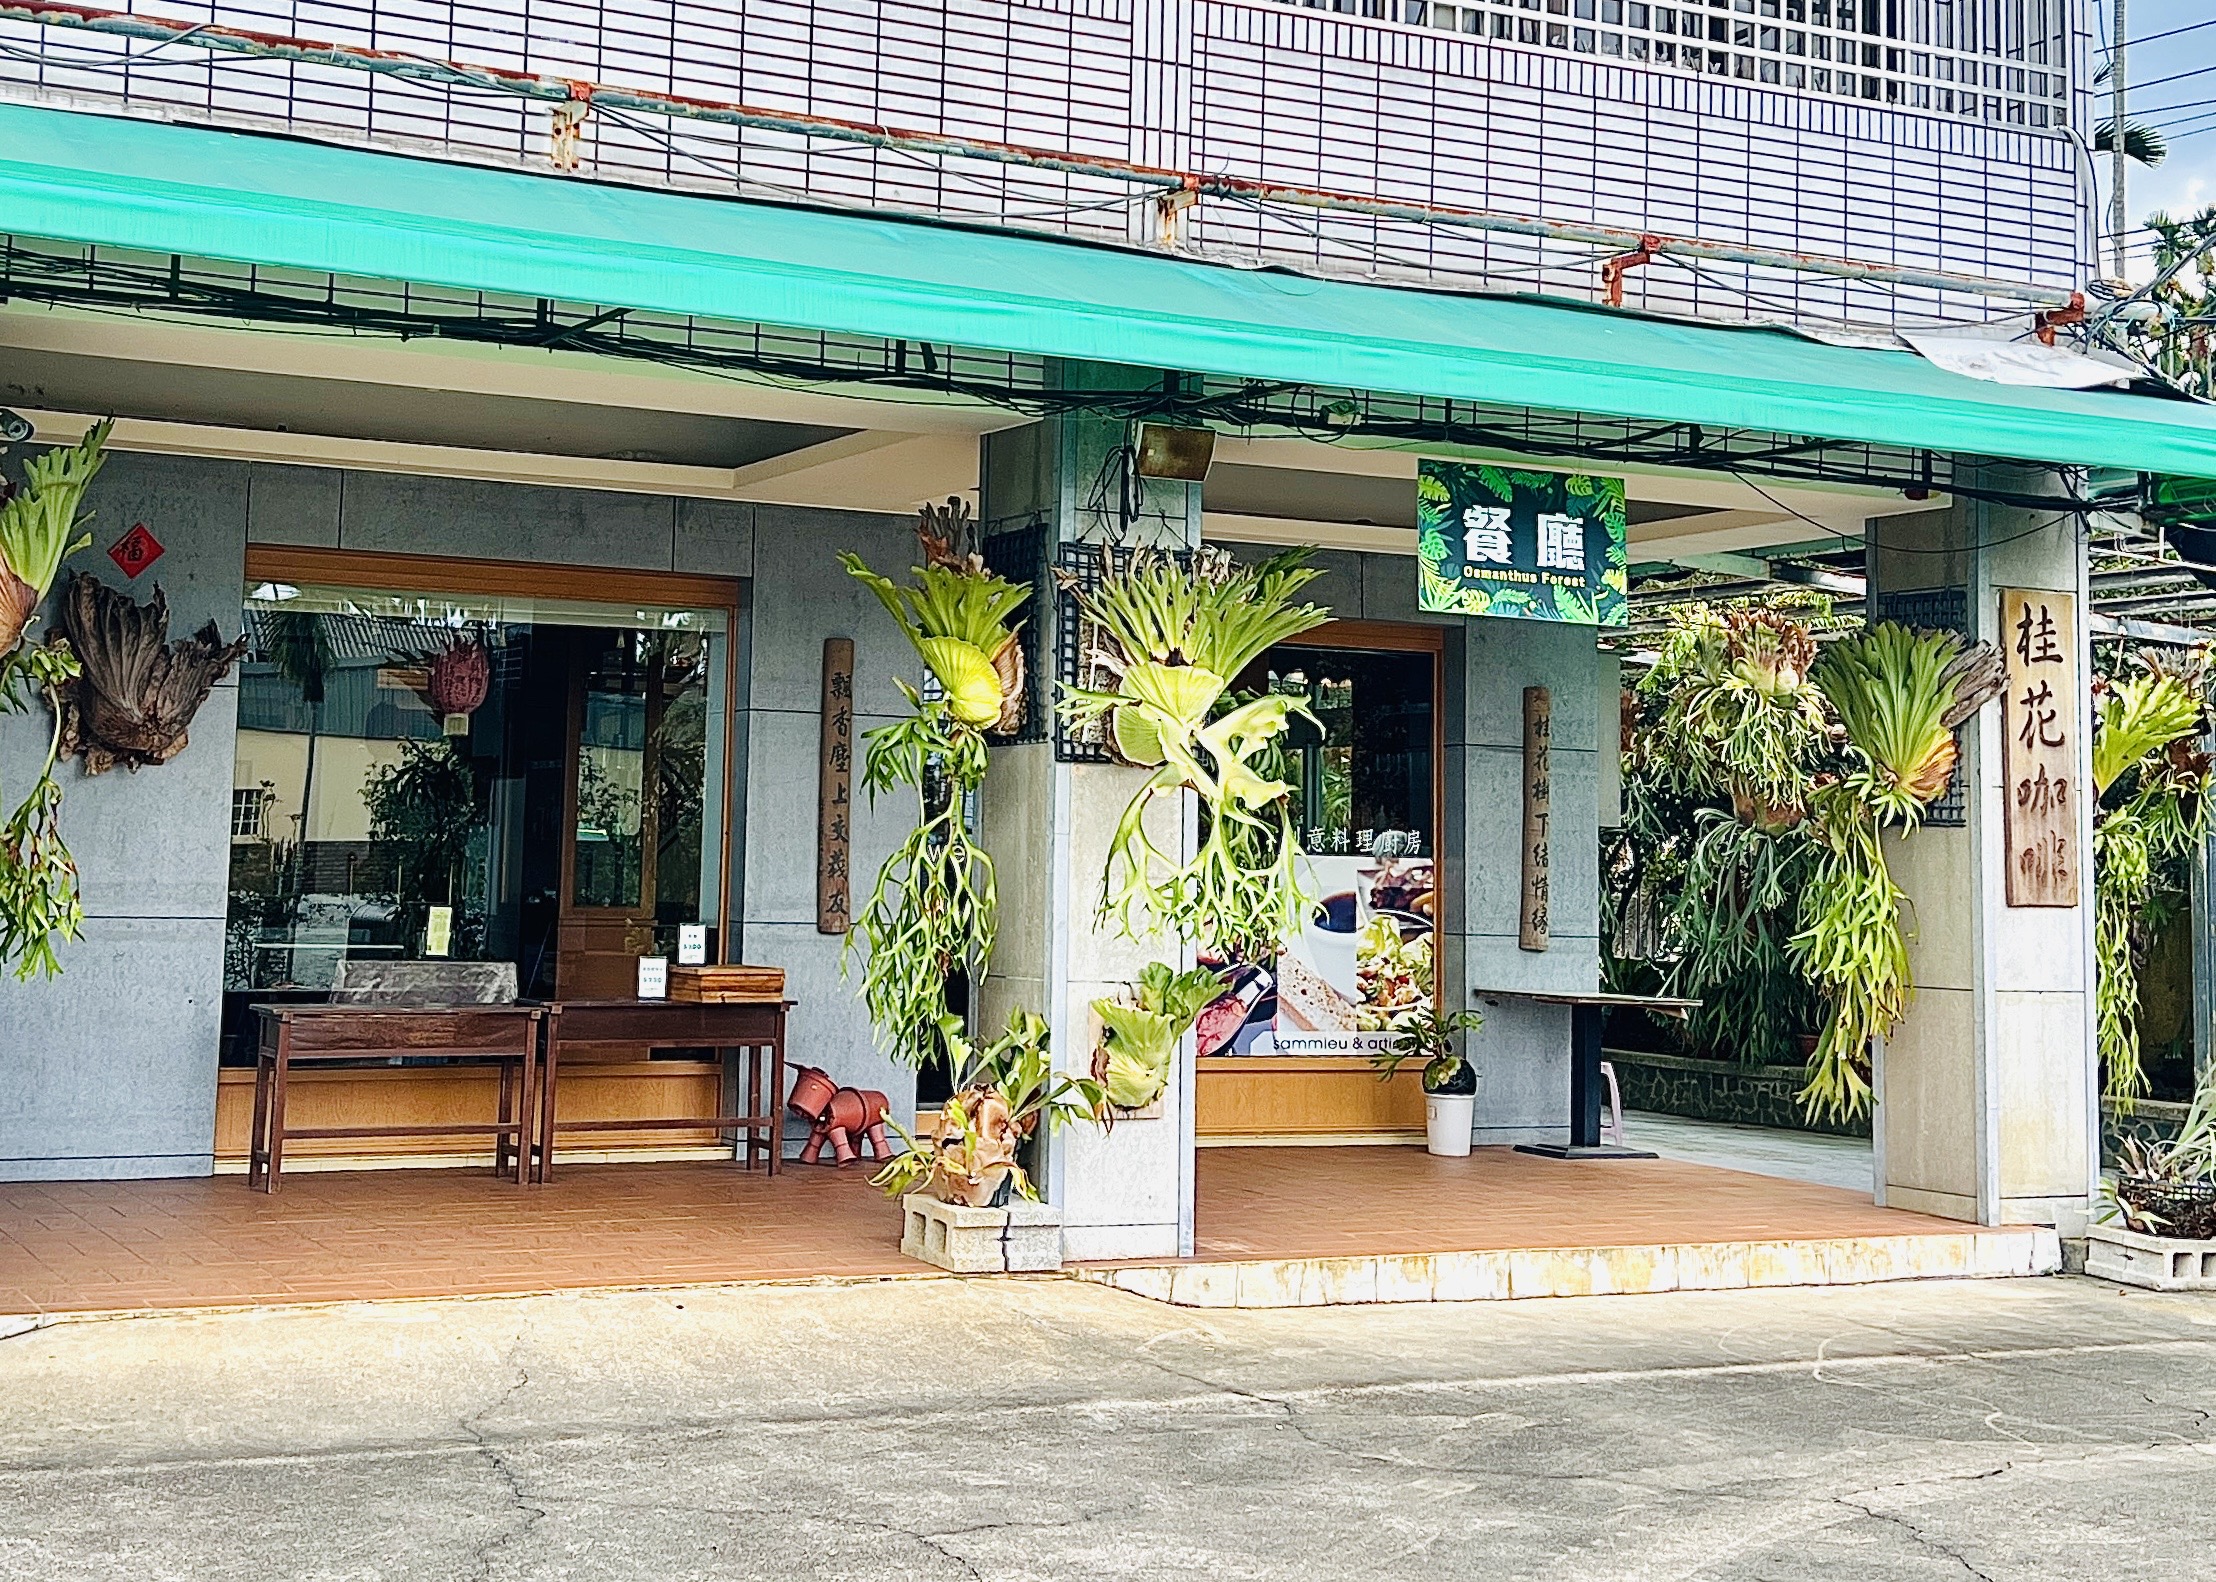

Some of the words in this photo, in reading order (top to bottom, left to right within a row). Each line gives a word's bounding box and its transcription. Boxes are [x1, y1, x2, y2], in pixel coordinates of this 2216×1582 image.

[1463, 504, 1585, 570] 餐廳
[1463, 565, 1538, 584] Osmanthus
[1541, 571, 1586, 587] Forest
[2016, 601, 2067, 891] 桂花咖啡
[1295, 826, 1422, 855] 意料理廚房
[1352, 1037, 1363, 1050] &
